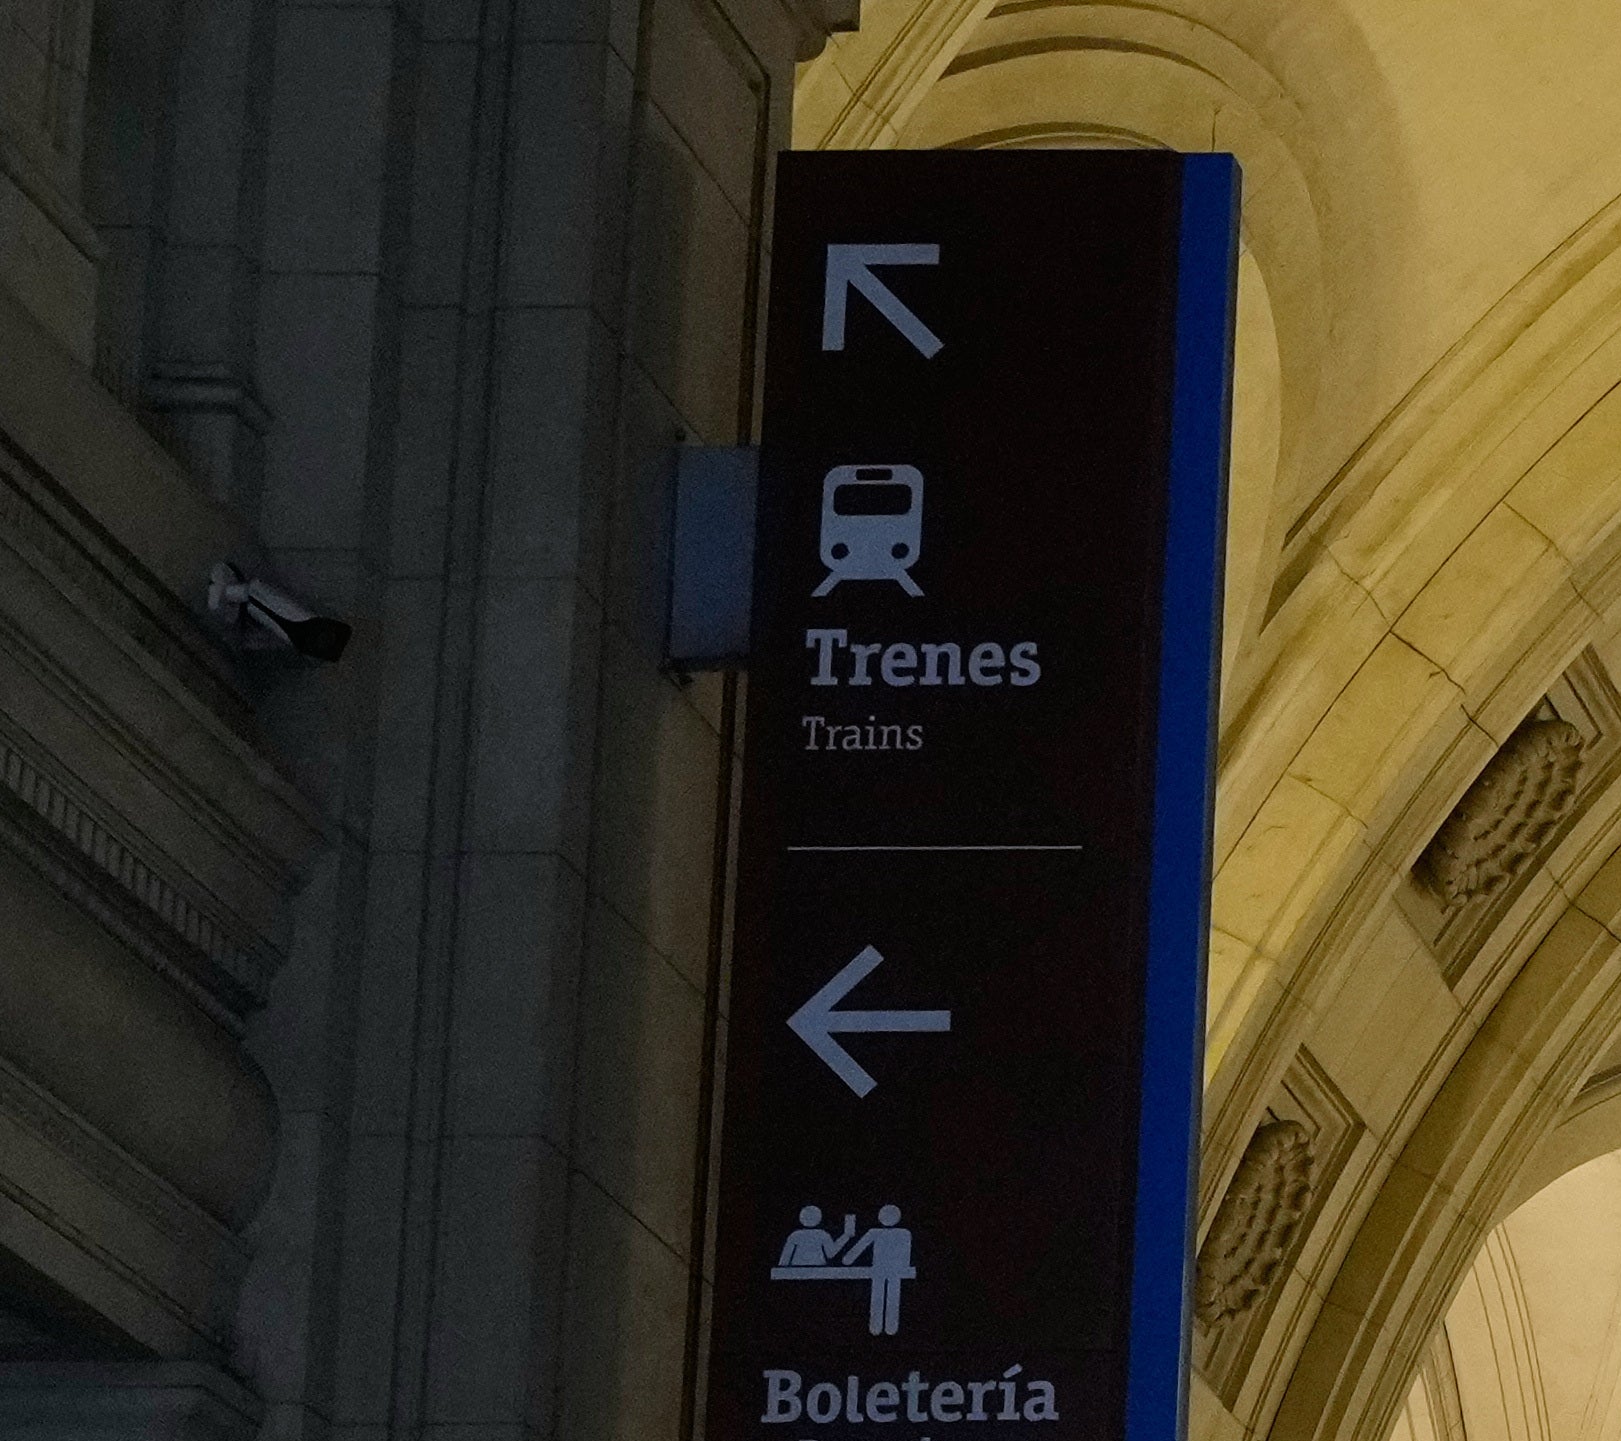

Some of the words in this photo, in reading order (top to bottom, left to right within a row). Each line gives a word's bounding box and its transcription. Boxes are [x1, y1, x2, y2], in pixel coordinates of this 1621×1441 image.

[806, 629, 1040, 686] Trenes
[802, 715, 923, 750] Trains
[761, 1364, 1059, 1423] Boletería
